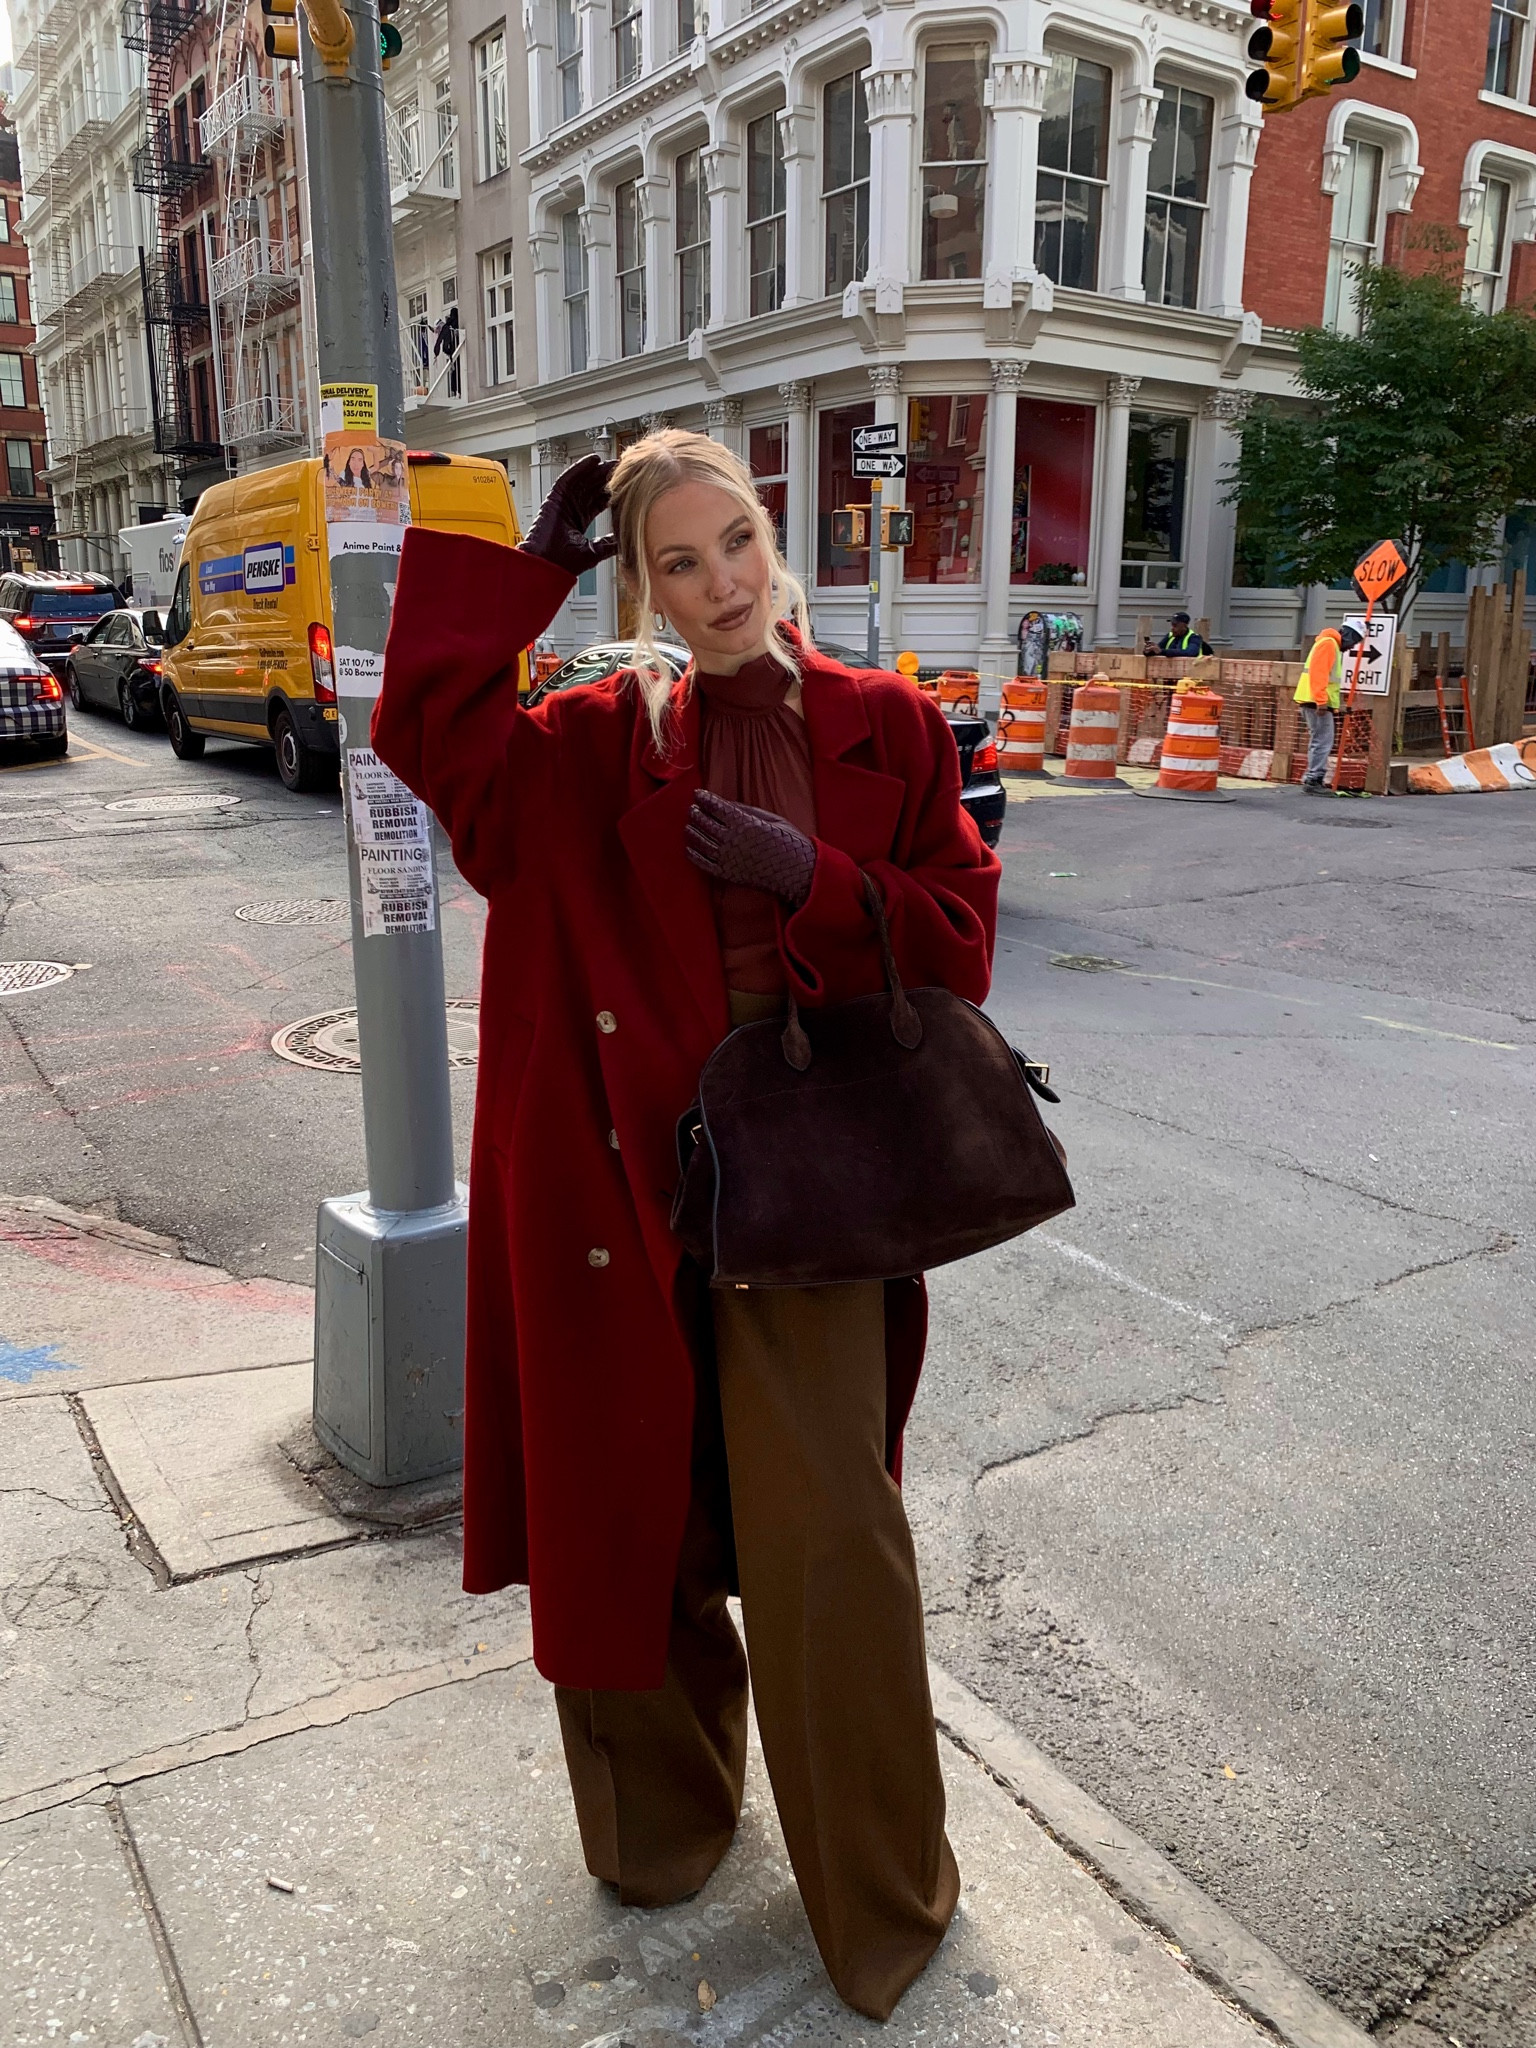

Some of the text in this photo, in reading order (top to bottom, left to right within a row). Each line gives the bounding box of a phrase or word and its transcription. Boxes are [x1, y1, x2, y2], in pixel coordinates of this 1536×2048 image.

[336, 387, 370, 395] DELIVERY
[859, 431, 892, 445] ONE WAY
[861, 460, 898, 470] ONE WAY
[343, 541, 402, 553] Anime Paint &
[246, 558, 281, 579] PENSKE
[1358, 559, 1401, 582] SLOW
[1367, 623, 1385, 638] EP
[339, 658, 375, 668] SAT 10/19
[339, 667, 384, 678] @ 50 Bower
[1345, 669, 1382, 686] RGHT
[356, 771, 383, 780] FLOOR
[369, 805, 418, 819] RUBBISH
[372, 817, 418, 830] REMOVAL
[374, 828, 418, 841] DEMOLITION
[361, 848, 422, 861] PAINTING
[368, 867, 396, 875] FLOOR
[381, 900, 427, 912] RUBBISH
[383, 911, 428, 923] REMOVAL
[385, 923, 428, 935] DEMOLITION
